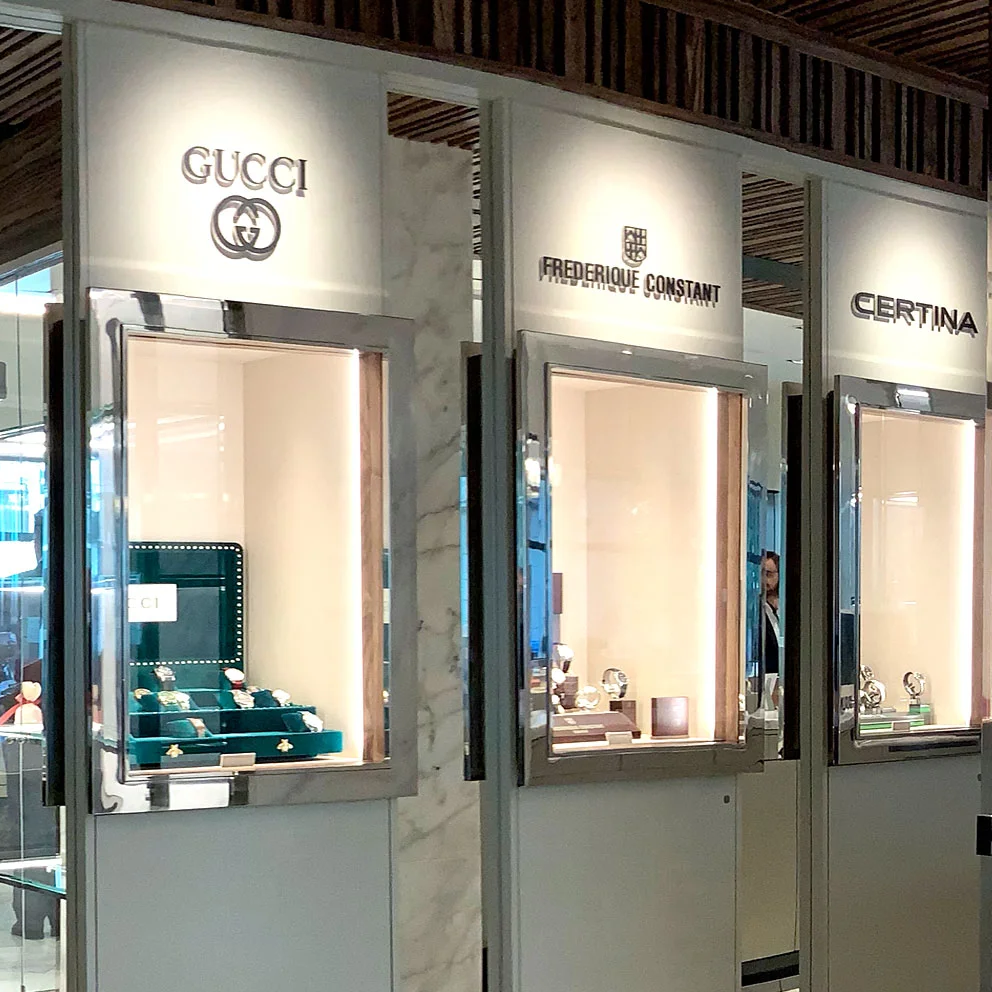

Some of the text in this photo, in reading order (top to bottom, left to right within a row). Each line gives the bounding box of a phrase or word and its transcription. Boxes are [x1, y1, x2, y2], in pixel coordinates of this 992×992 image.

[182, 146, 308, 197] GUCCI
[541, 256, 721, 305] FREDERIQUE CONSTANT
[852, 292, 978, 336] CERTINA
